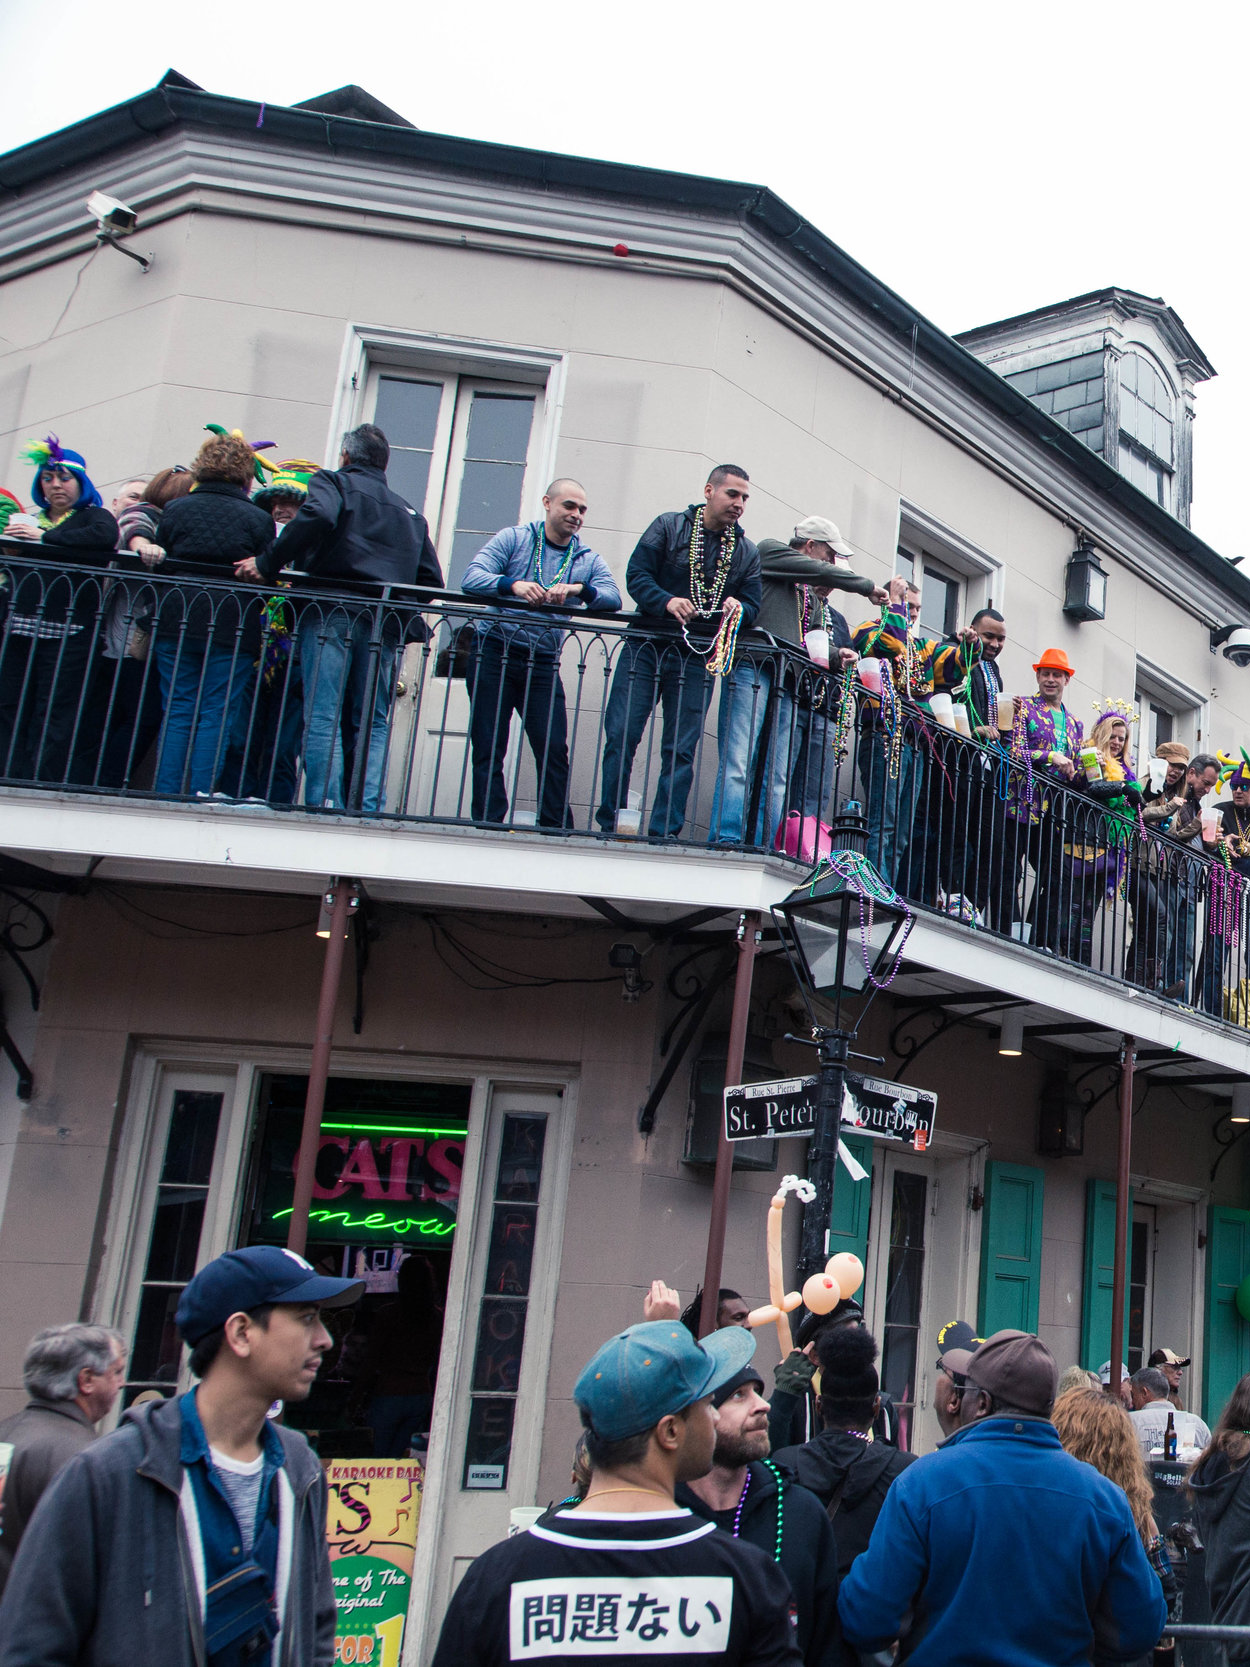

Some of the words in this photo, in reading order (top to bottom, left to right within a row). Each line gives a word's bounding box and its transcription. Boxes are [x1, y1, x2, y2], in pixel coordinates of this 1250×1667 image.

[752, 1087, 765, 1097] Rue
[766, 1086, 775, 1095] St.
[777, 1083, 796, 1094] Pierre
[868, 1080, 882, 1091] Rue
[884, 1084, 913, 1101] Bourbon
[730, 1105, 756, 1132] St.
[291, 1135, 467, 1200] CATS
[332, 1466, 394, 1479] KARAOKE
[396, 1466, 422, 1478] BAR
[354, 1570, 373, 1592] of
[378, 1569, 406, 1585] The
[335, 1591, 386, 1614] riginal
[523, 1592, 722, 1647] 問題ない
